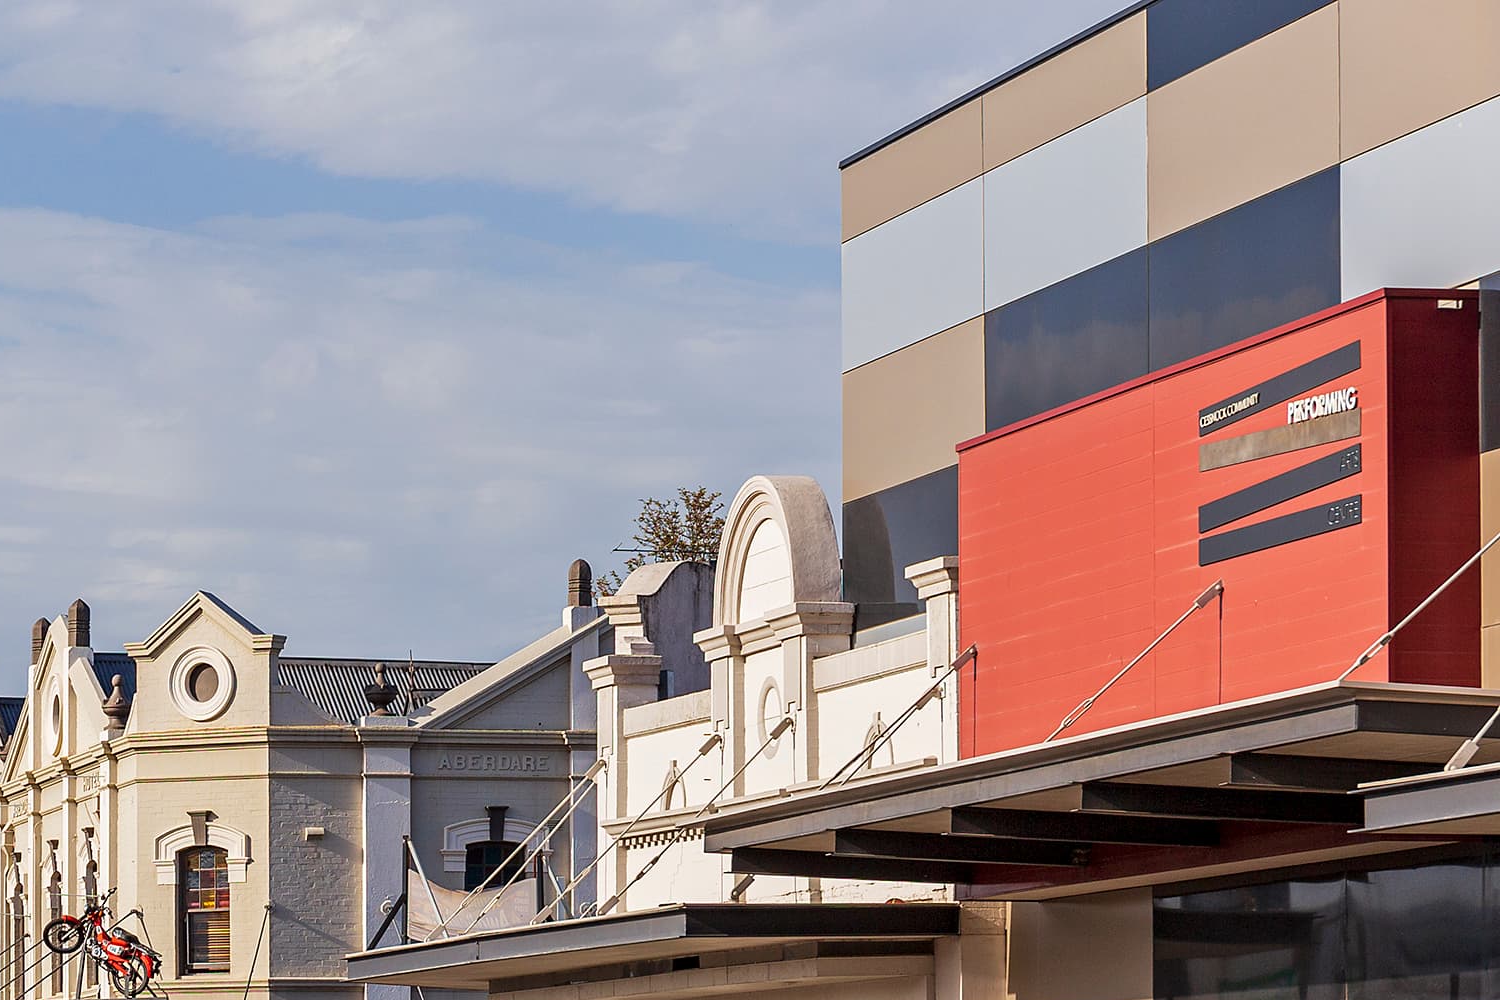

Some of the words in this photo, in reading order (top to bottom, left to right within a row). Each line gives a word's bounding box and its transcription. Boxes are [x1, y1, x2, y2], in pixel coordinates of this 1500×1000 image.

[1287, 386, 1358, 425] PERFORMING
[1200, 407, 1227, 428] CESSNOCK
[438, 754, 550, 772] ABERDARE
